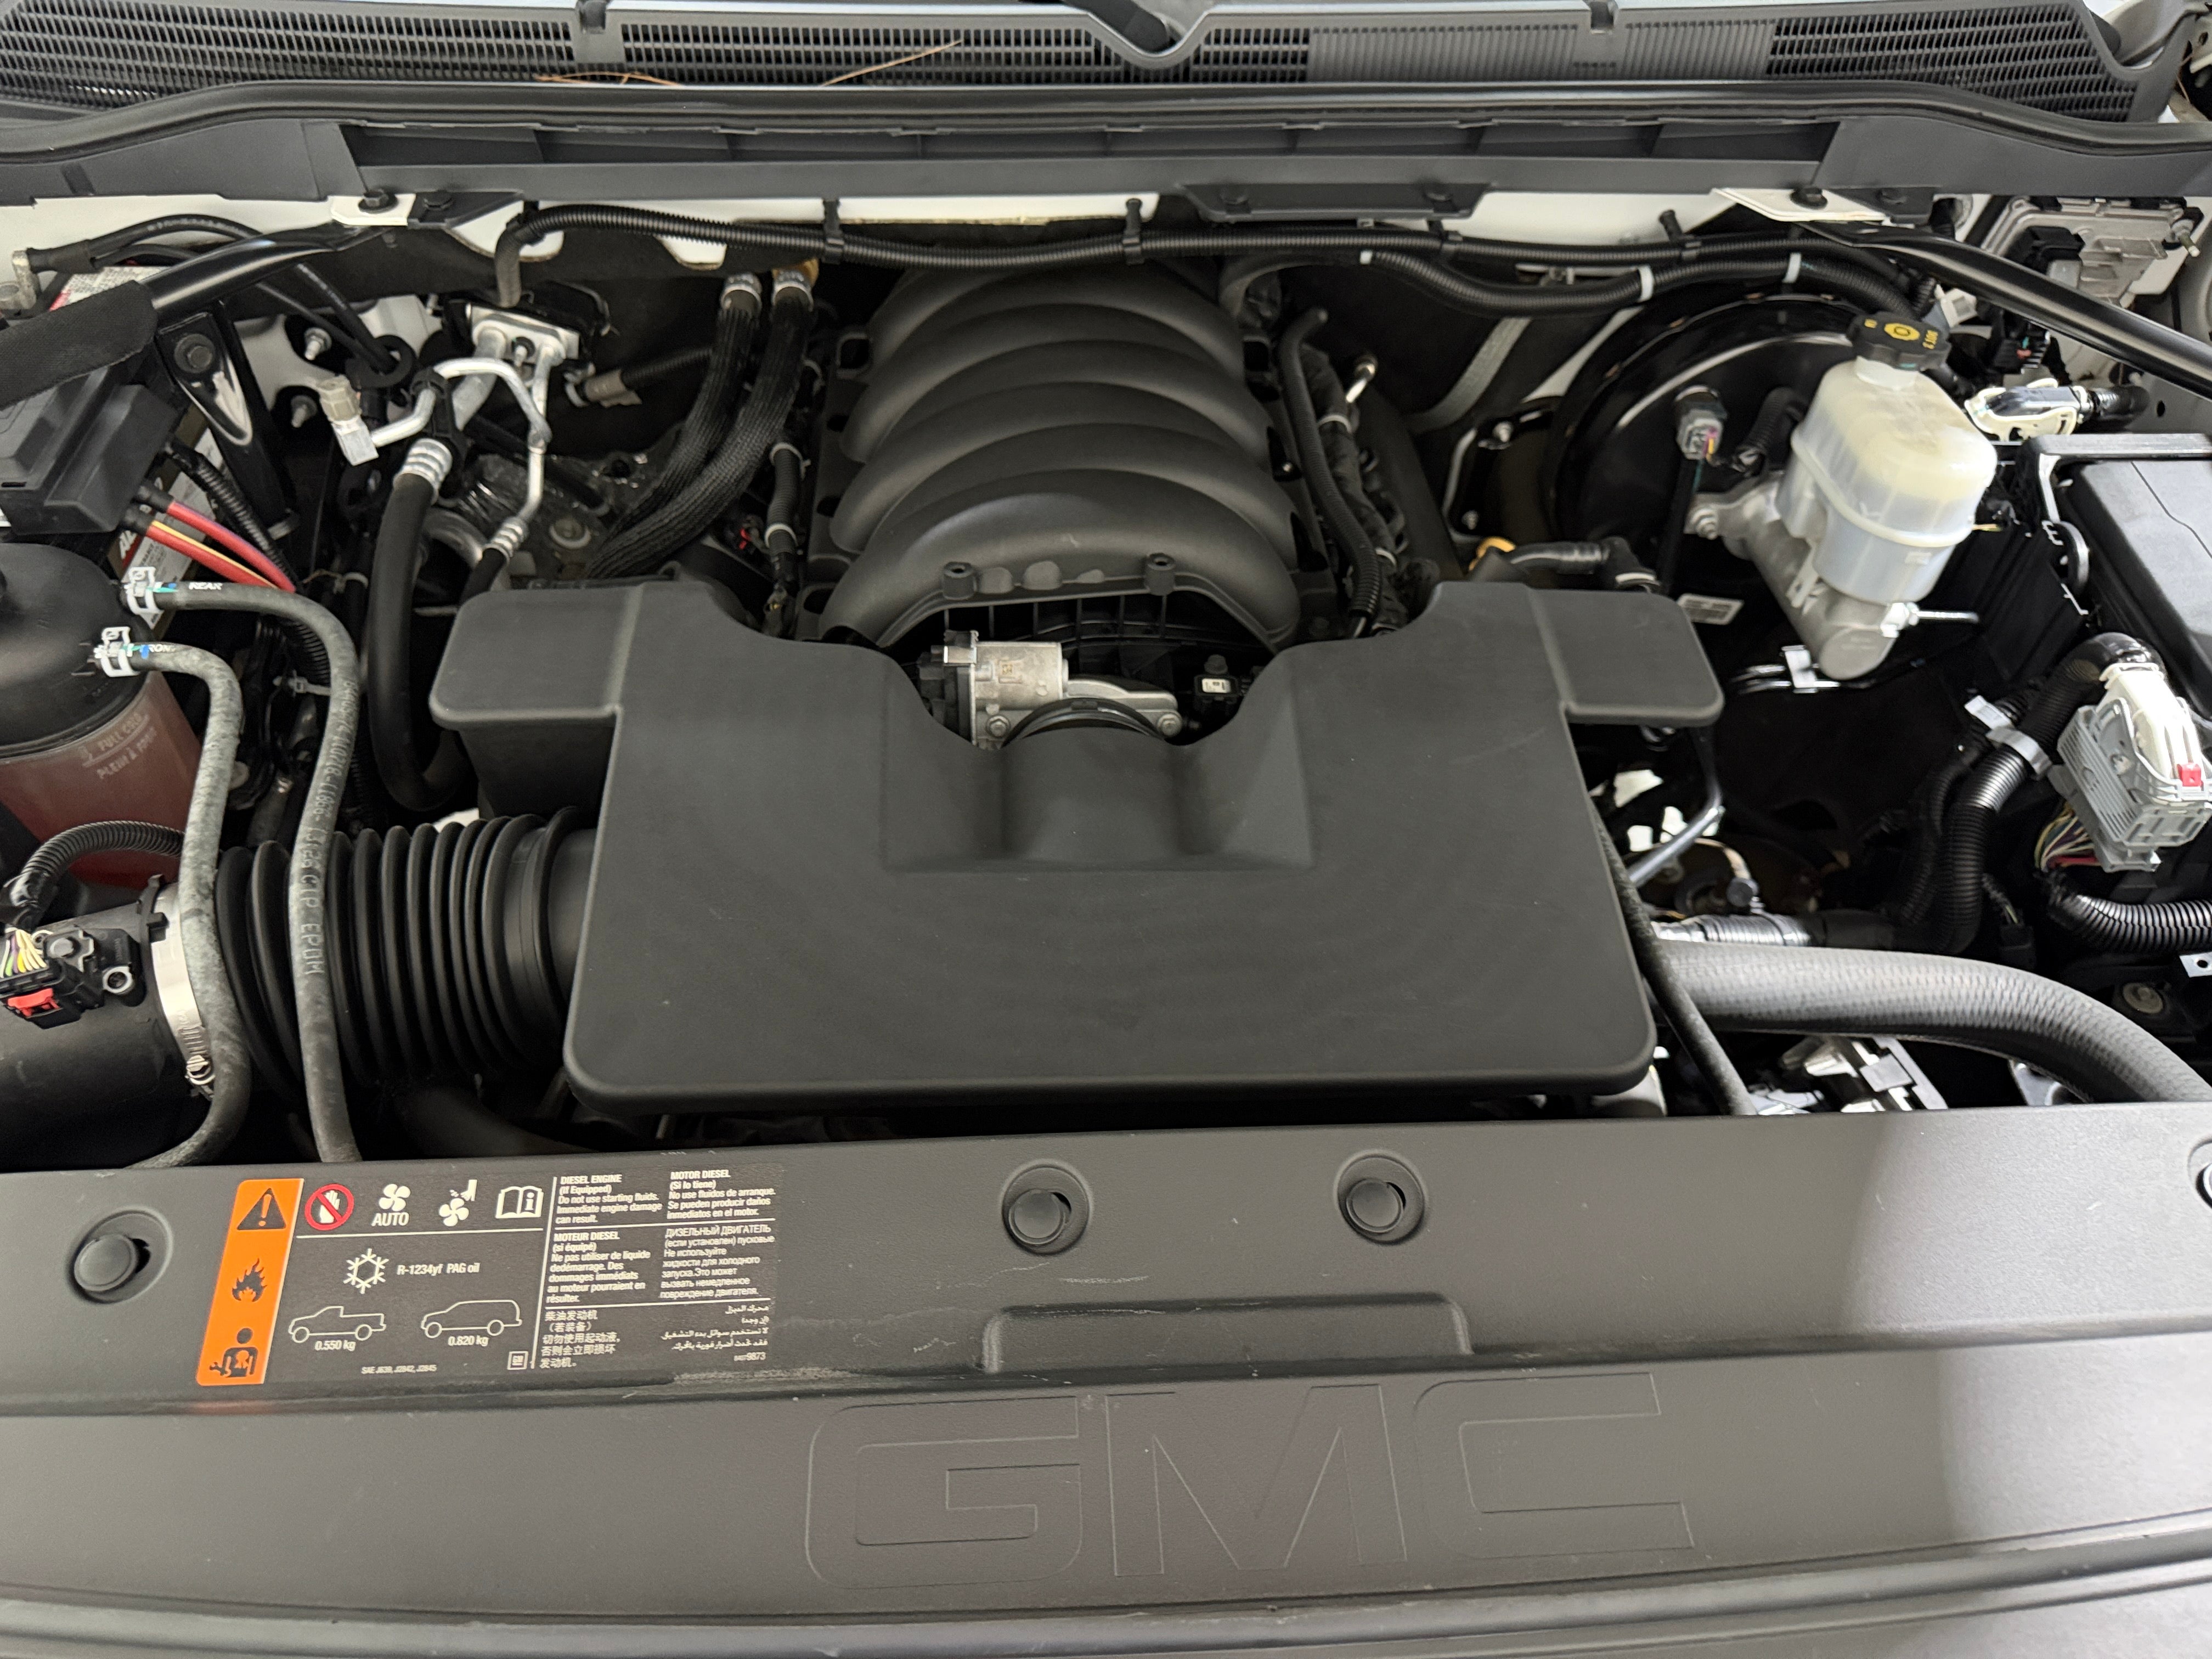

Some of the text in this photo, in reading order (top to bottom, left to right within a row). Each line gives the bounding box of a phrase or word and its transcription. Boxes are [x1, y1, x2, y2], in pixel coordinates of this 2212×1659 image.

[560, 1174, 622, 1184] DIESEL ENGINE
[670, 1170, 731, 1180] MOTOR DIESEL
[571, 1184, 612, 1195] Equipped)
[670, 1181, 681, 1191] (Si
[692, 1180, 716, 1189] tiene)
[558, 1196, 569, 1204] Do
[571, 1195, 585, 1204] not
[602, 1194, 633, 1203] starting
[635, 1193, 659, 1201] fluids.
[698, 1190, 725, 1198] fluidos
[738, 1188, 776, 1197] arranque.
[557, 1203, 663, 1214] Immediate engine damage
[668, 1197, 771, 1210] Se pueden producir daños
[371, 1212, 409, 1226] AUTO
[572, 1215, 598, 1223] result.
[554, 1231, 620, 1242] MOTEUR DIESEL
[665, 1224, 771, 1239] ДИЗЕЛЬНЫЙ ДВИГАТЕЛЬ
[553, 1242, 597, 1254] (si équipé)
[664, 1249, 676, 1257] Не
[551, 1254, 563, 1262] Ne
[565, 1254, 580, 1263] pas
[611, 1251, 622, 1260] de
[623, 1250, 651, 1261] liquide
[701, 1259, 717, 1267] для
[719, 1257, 760, 1265] холодного
[397, 1262, 480, 1276] R-1234yf PAG oil
[607, 1262, 624, 1270] Des
[549, 1274, 594, 1283] dommages
[590, 1282, 634, 1293] pourraient
[545, 1310, 598, 1322] 柴油发动机
[314, 1340, 356, 1351] 0.550 kg
[448, 1335, 489, 1347] 0.820 kg
[361, 1366, 376, 1374] SAE
[805, 1372, 1694, 1589] GMC
